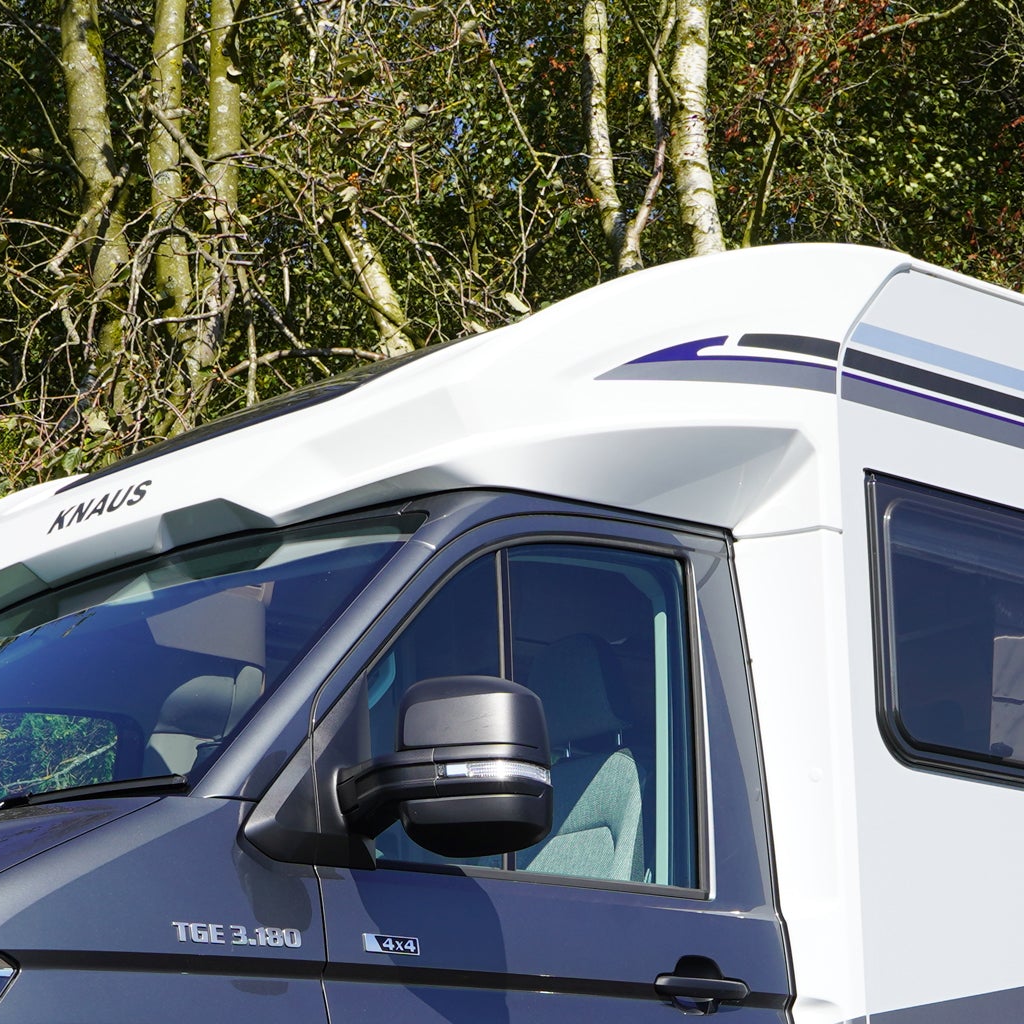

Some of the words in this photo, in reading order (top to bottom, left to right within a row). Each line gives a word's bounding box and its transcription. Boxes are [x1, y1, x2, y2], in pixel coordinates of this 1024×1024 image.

[46, 479, 153, 535] KNAUS
[172, 921, 226, 945] TGE
[230, 925, 302, 949] 3.180
[382, 937, 417, 953] 4x4
